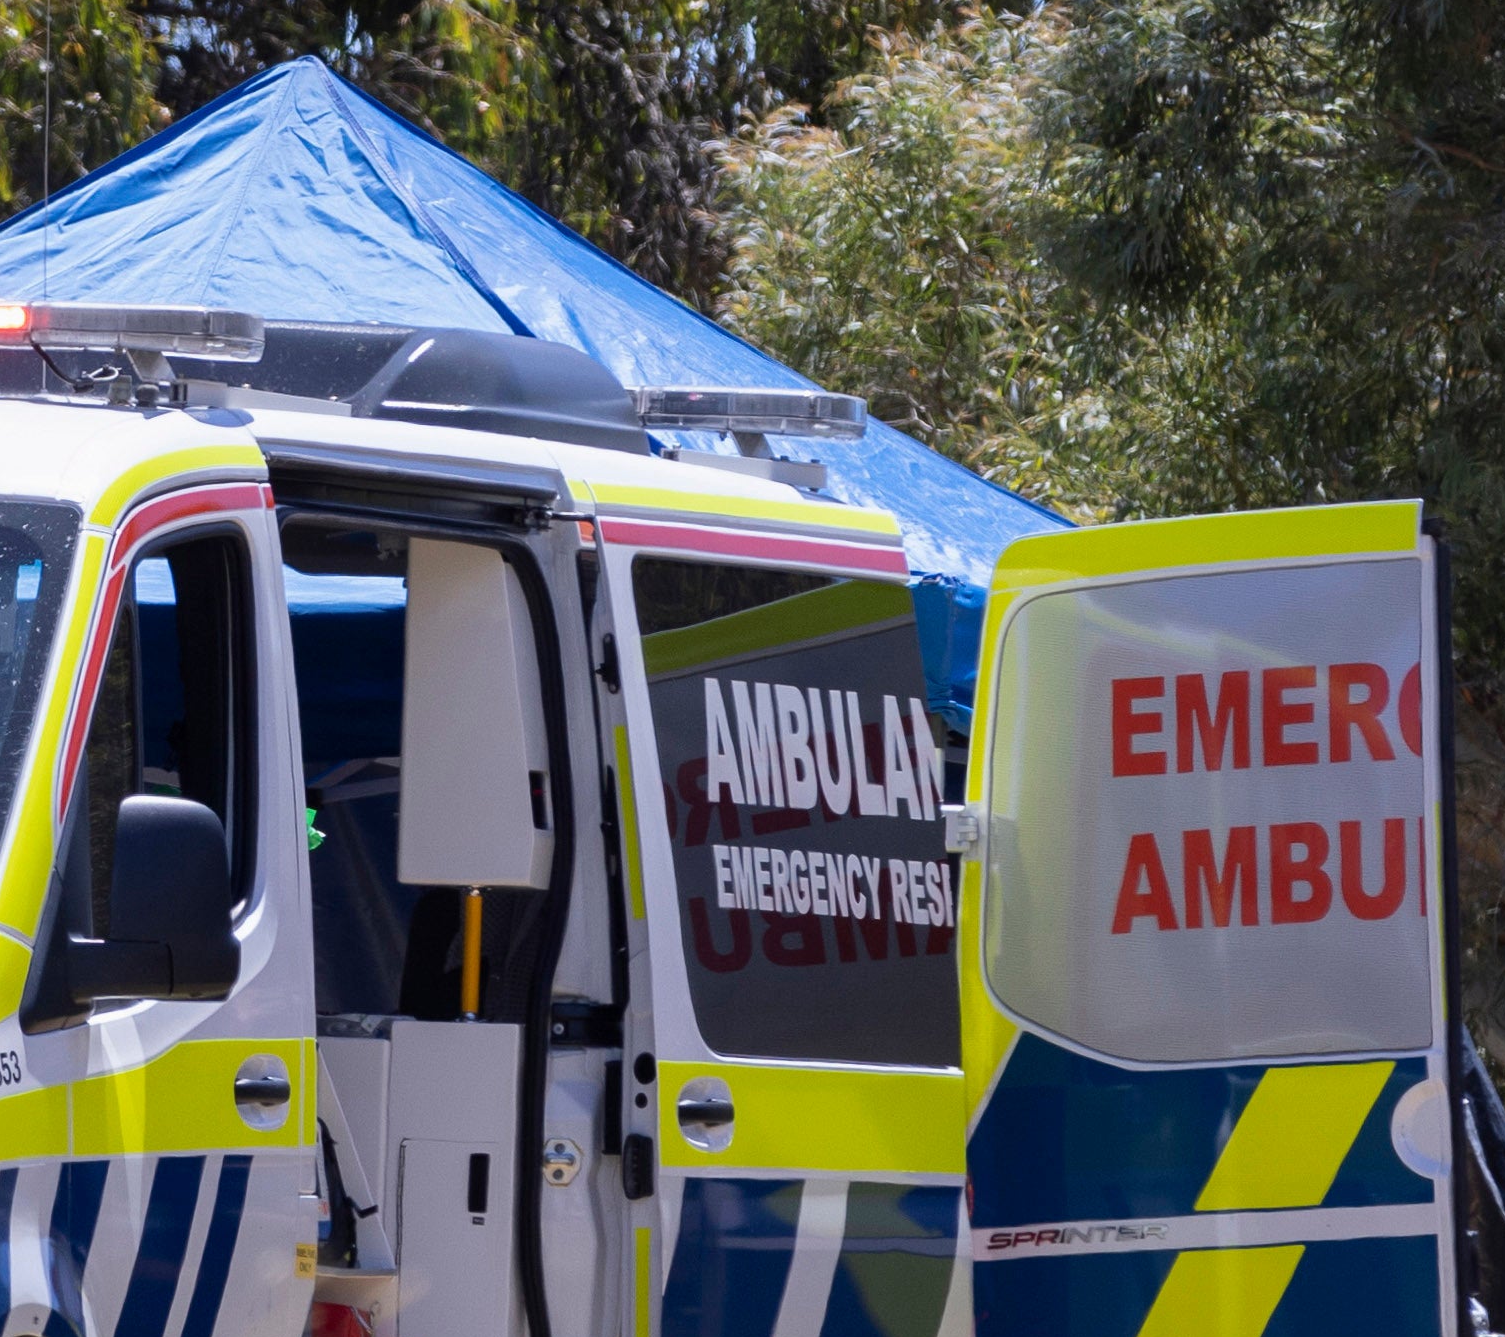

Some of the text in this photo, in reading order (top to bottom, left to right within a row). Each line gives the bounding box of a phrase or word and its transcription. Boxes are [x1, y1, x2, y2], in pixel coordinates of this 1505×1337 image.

[712, 844, 882, 921] EMERGENCY
[1110, 815, 1428, 935] AMBU
[987, 1223, 1170, 1250] SPRINTER
